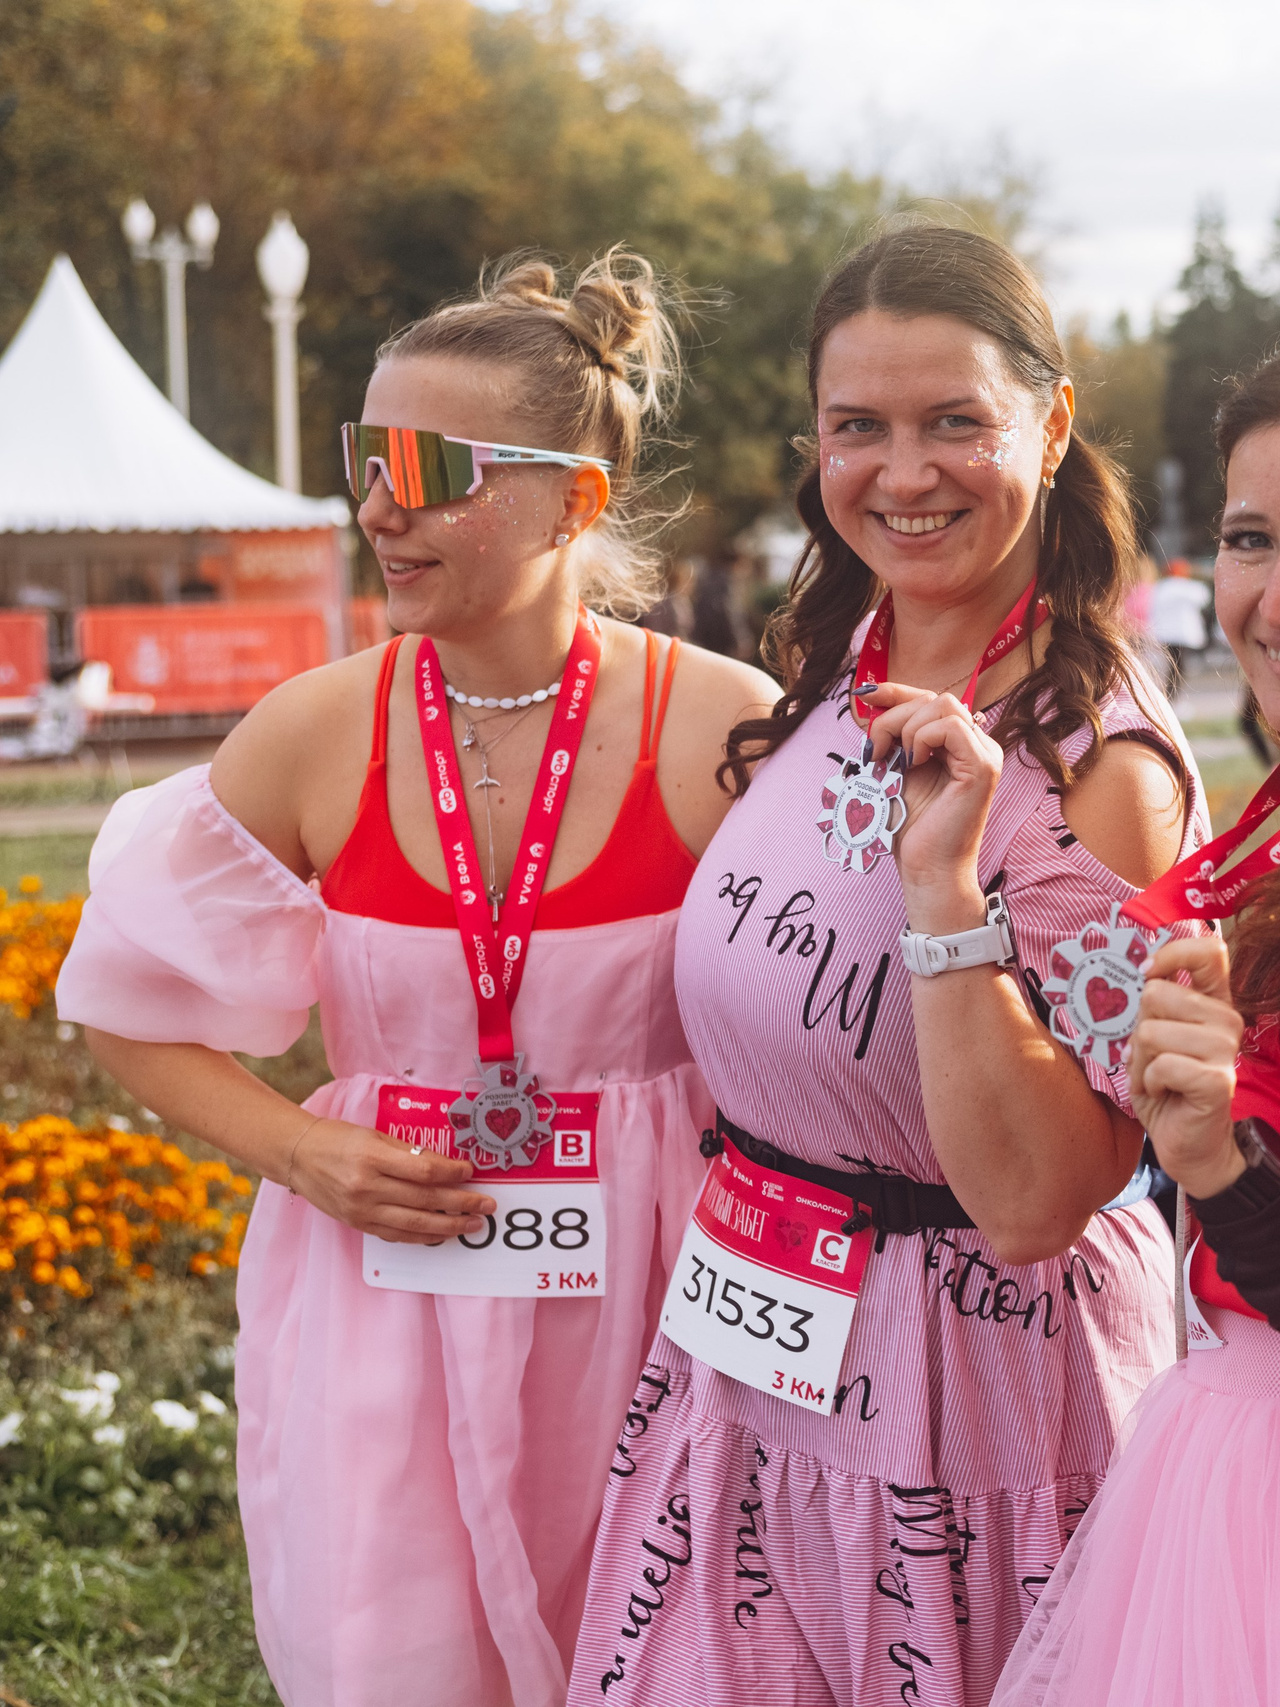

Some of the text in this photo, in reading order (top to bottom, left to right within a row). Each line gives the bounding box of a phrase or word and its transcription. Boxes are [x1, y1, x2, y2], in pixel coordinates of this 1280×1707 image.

[987, 623, 1023, 658] ВФЛА
[421, 658, 434, 701] ВФЛА
[565, 679, 586, 721] ВФЛА
[853, 780, 882, 795] РОЗОВЫЙ
[856, 790, 874, 801] ЗАБЕГ
[452, 841, 470, 884] ВФЛА
[517, 862, 538, 906] ВФЛА
[730, 1198, 770, 1243] ЗАБЕГ
[795, 1195, 849, 1218] ОНКОЛОГИКА
[537, 1272, 550, 1289] 3
[815, 1258, 841, 1271] КЛАСТЕР
[683, 1254, 814, 1353] 31533
[771, 1370, 786, 1390] 3
